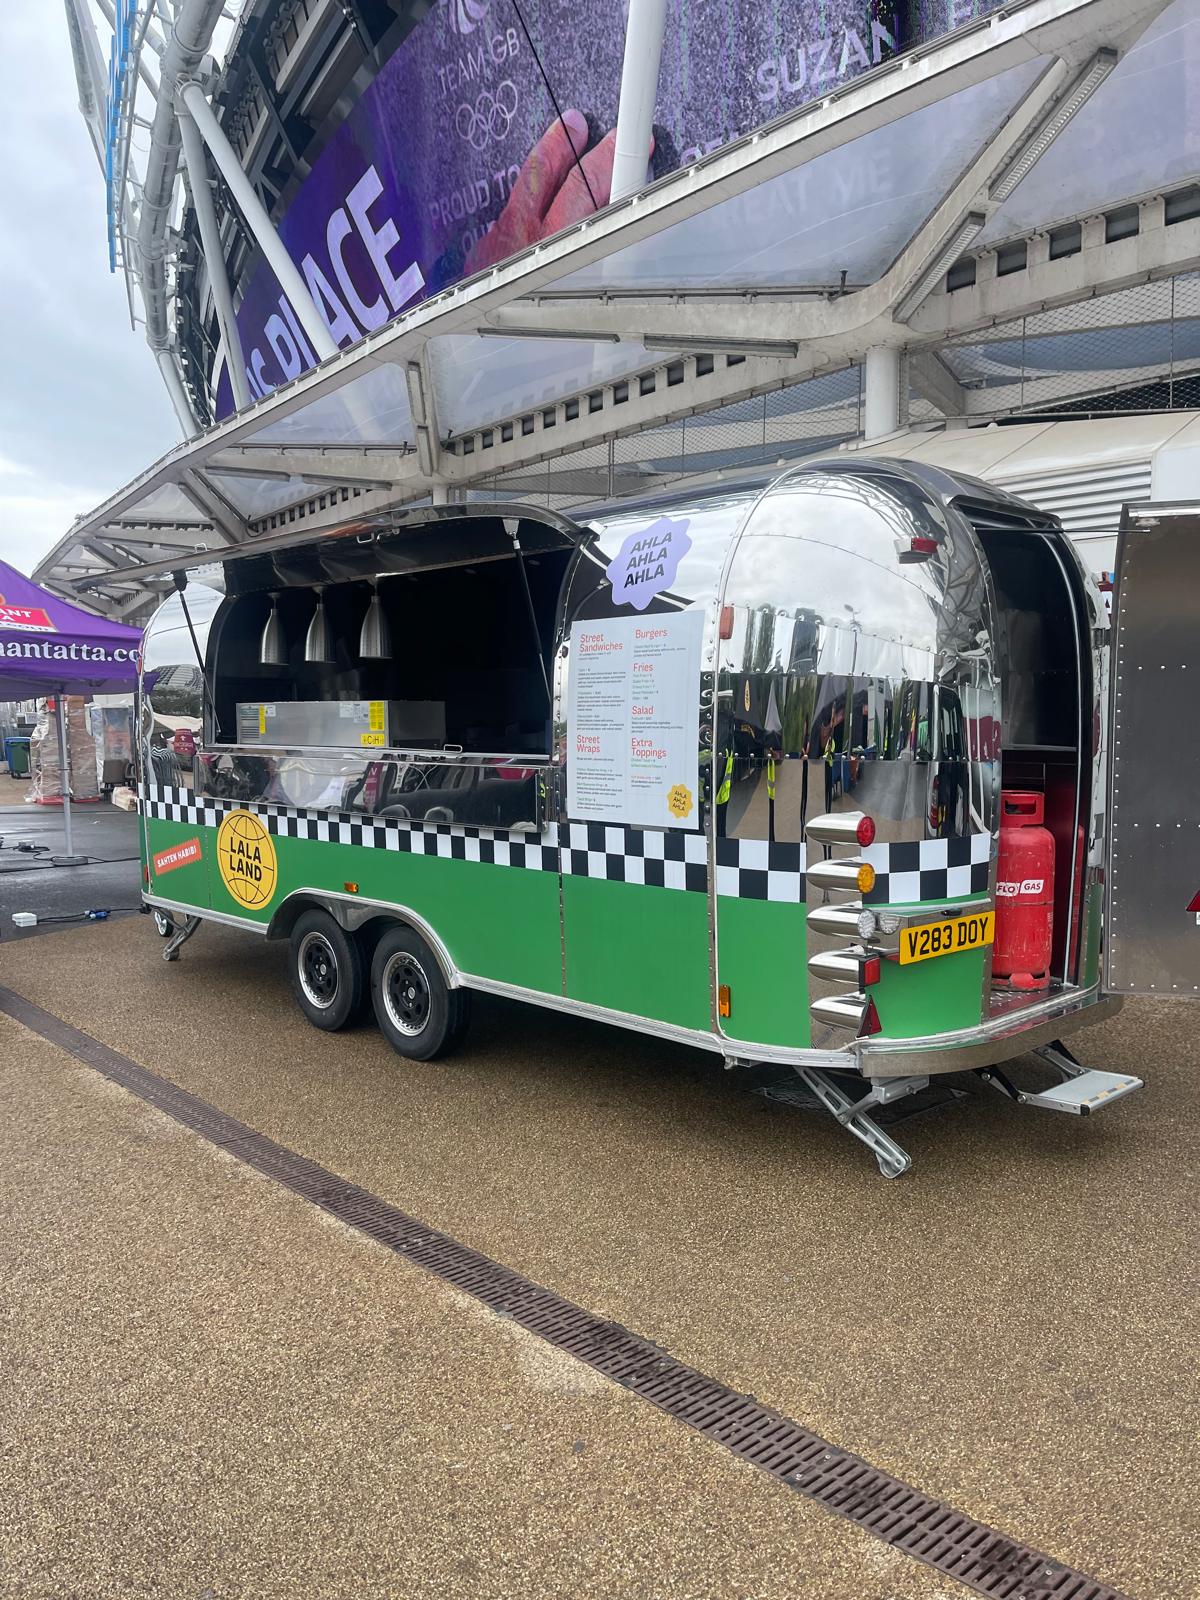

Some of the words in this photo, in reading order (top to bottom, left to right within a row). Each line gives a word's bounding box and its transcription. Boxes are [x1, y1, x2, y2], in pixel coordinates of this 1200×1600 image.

[438, 46, 488, 96] TEAM
[491, 27, 519, 63] GB
[429, 179, 490, 231] PROUD
[630, 531, 672, 554] AHLA
[626, 547, 668, 571] AHLA
[623, 563, 665, 589] AHLA
[580, 633, 604, 643] Street
[635, 629, 668, 640] Burgers
[579, 641, 623, 653] Sandwiches
[633, 662, 653, 672] Fries
[632, 705, 654, 715] Salad
[576, 735, 600, 744] Street
[631, 738, 653, 747] Extra
[576, 744, 601, 754] Wraps
[631, 747, 667, 759] Toppings
[674, 790, 687, 799] AHLA
[673, 796, 686, 805] AHLA
[672, 802, 685, 811] AHLA
[230, 836, 262, 864] LALA
[157, 852, 178, 868] SAHTEN
[178, 845, 197, 860] HABIBI
[229, 854, 262, 882] LAND
[997, 885, 1016, 893] FLO
[1024, 883, 1041, 891] GAS
[908, 924, 953, 958] V283
[957, 916, 989, 947] DOY
